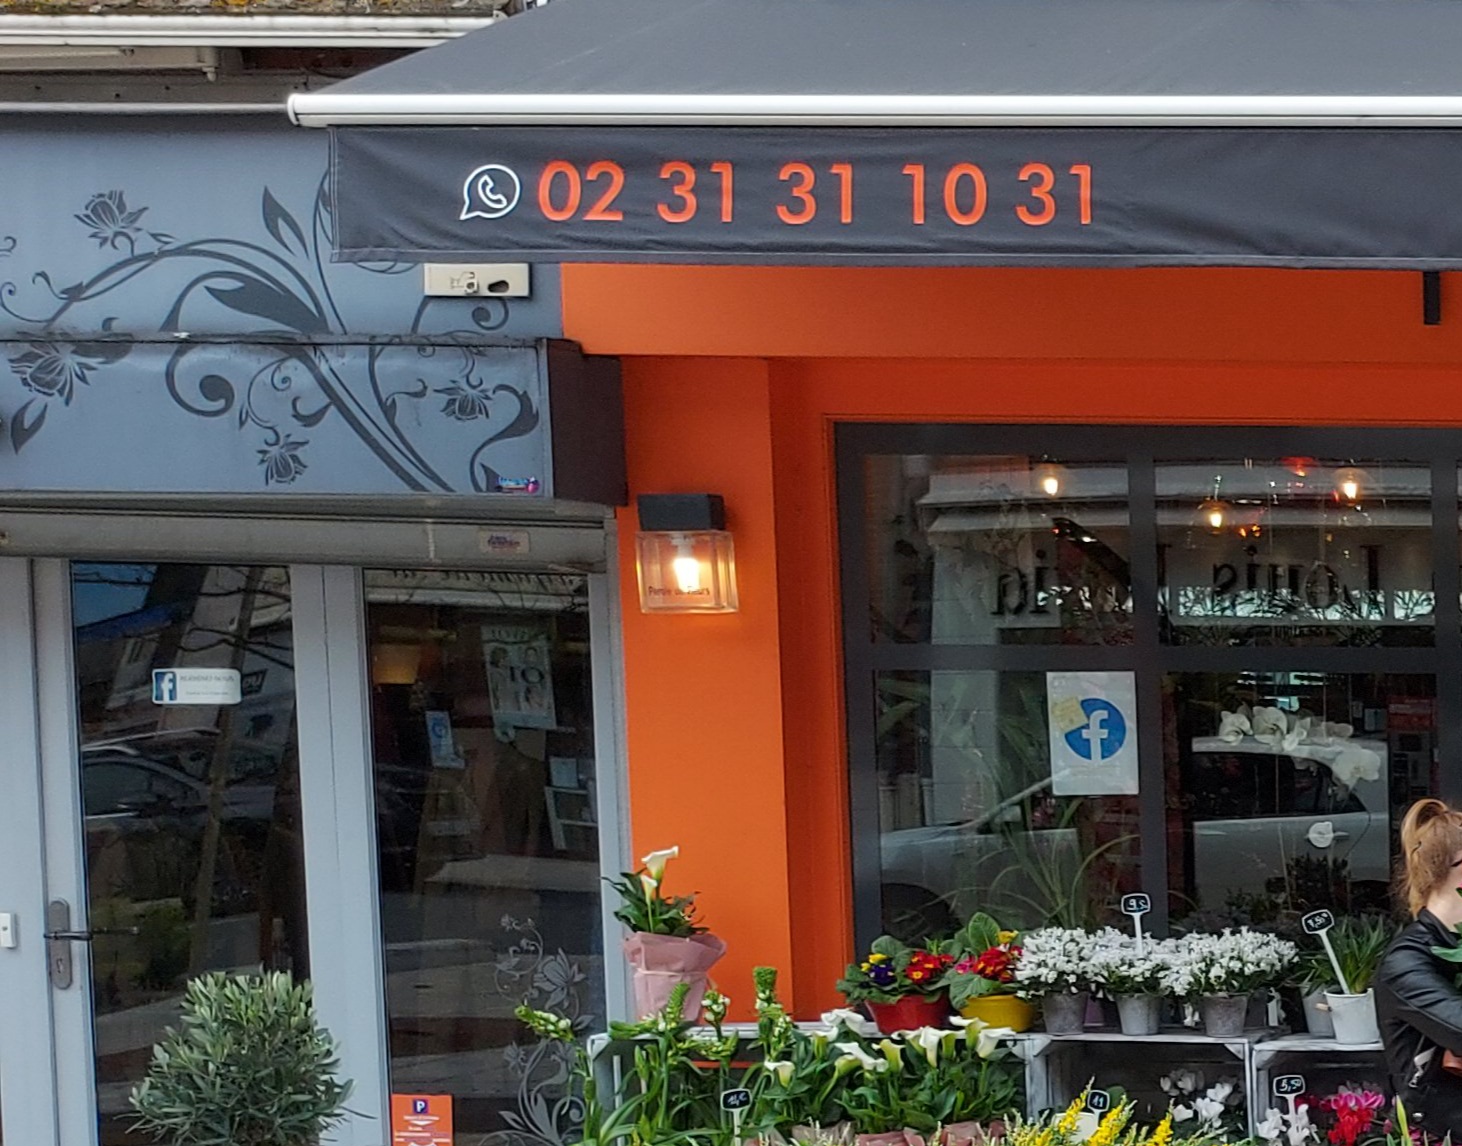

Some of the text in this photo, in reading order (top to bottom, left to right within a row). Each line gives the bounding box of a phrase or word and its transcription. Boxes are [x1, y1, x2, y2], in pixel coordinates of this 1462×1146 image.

[538, 160, 1092, 226] 02 31 31 10 31
